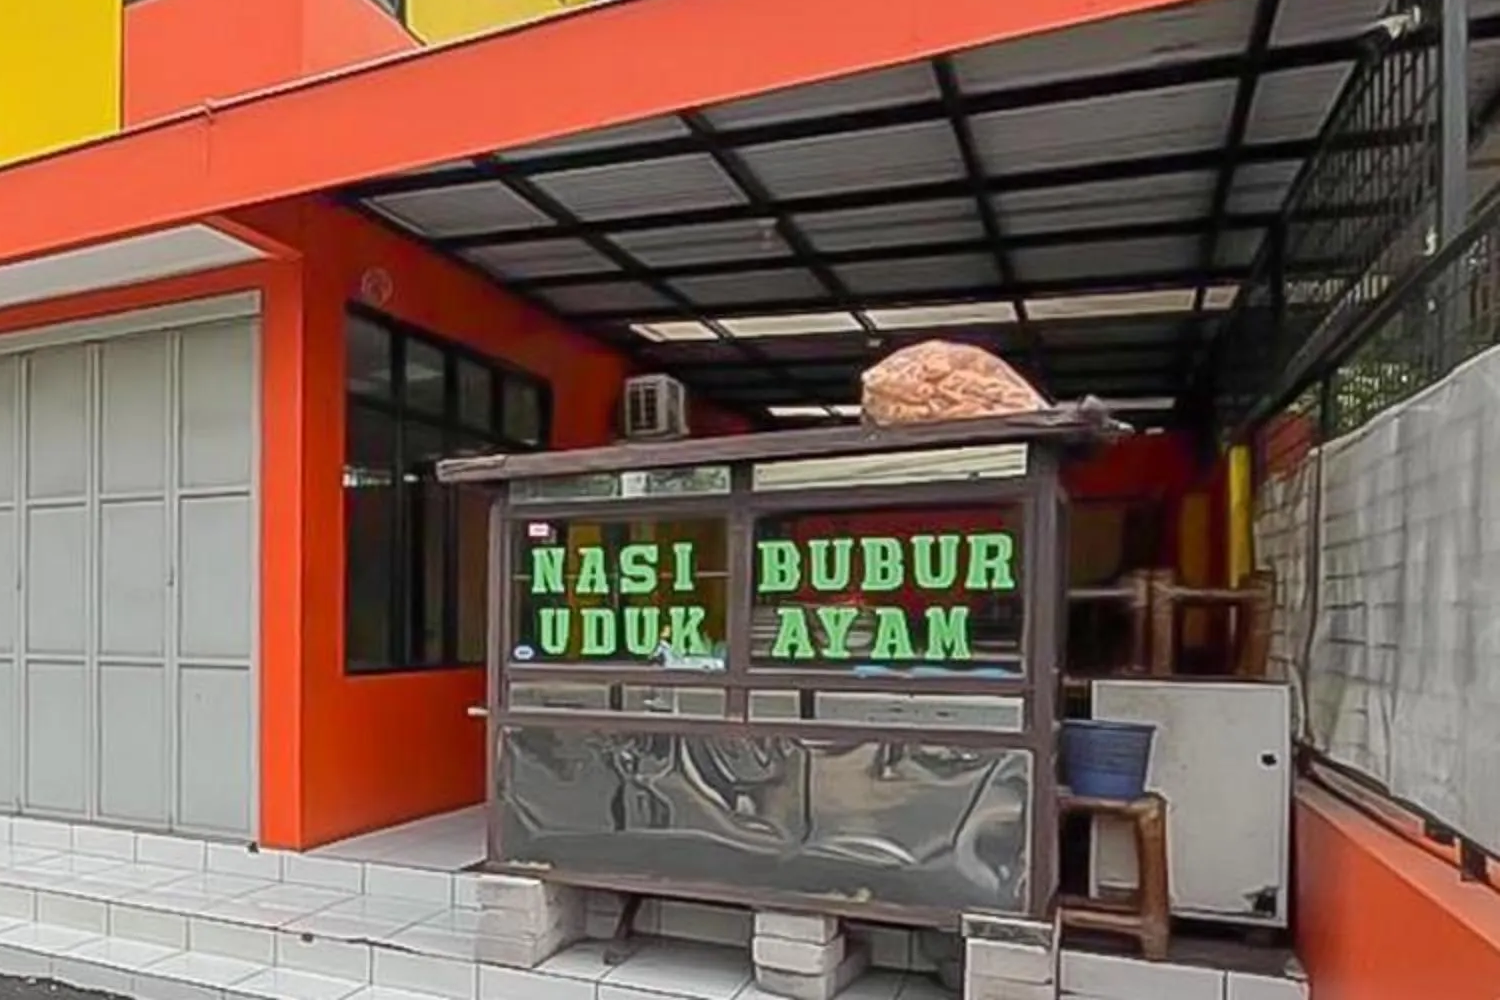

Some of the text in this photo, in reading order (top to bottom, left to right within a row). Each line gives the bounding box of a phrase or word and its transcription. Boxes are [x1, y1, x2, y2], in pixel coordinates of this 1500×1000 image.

[531, 542, 694, 593] NASI
[757, 533, 1015, 592] BUBUR
[539, 606, 710, 656] UDUK
[771, 606, 972, 660] AYAM
